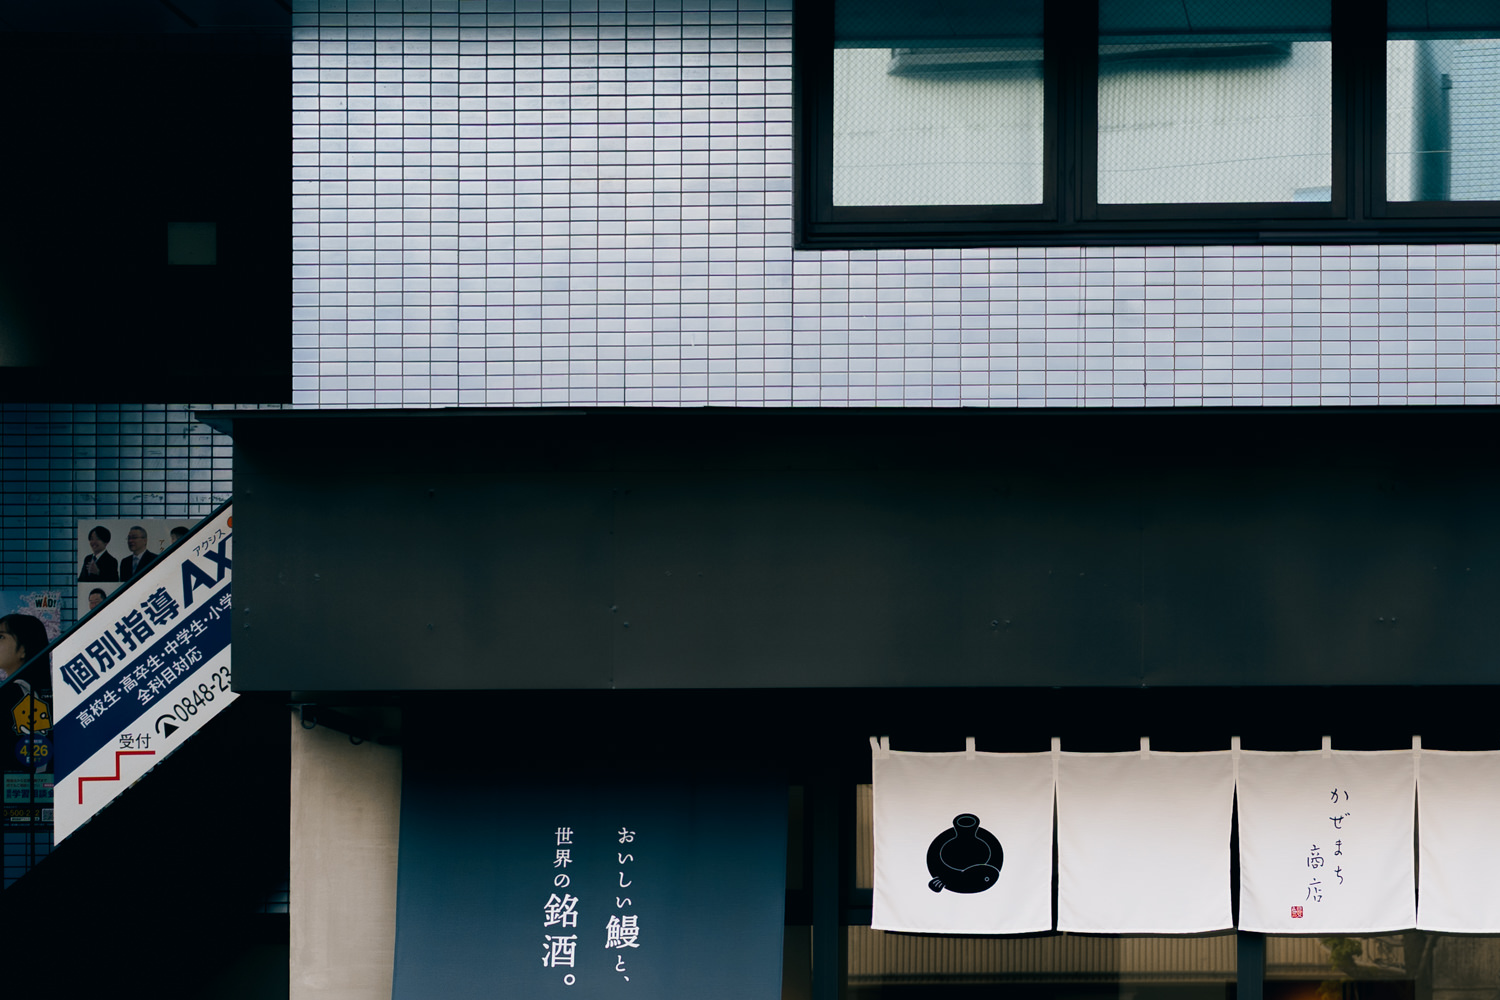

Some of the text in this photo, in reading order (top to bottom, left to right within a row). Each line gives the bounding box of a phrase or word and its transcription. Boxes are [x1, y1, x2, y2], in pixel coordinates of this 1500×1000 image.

[192, 528, 226, 557] アクシス
[59, 586, 181, 695] 個別指導
[137, 646, 203, 706] 全科目対応
[119, 733, 151, 749] 受付
[1306, 844, 1325, 903] 商店
[1329, 788, 1351, 885] かぜまち
[541, 827, 579, 987] 世界の銘酒。
[604, 827, 641, 983] おいしい鰻と、
